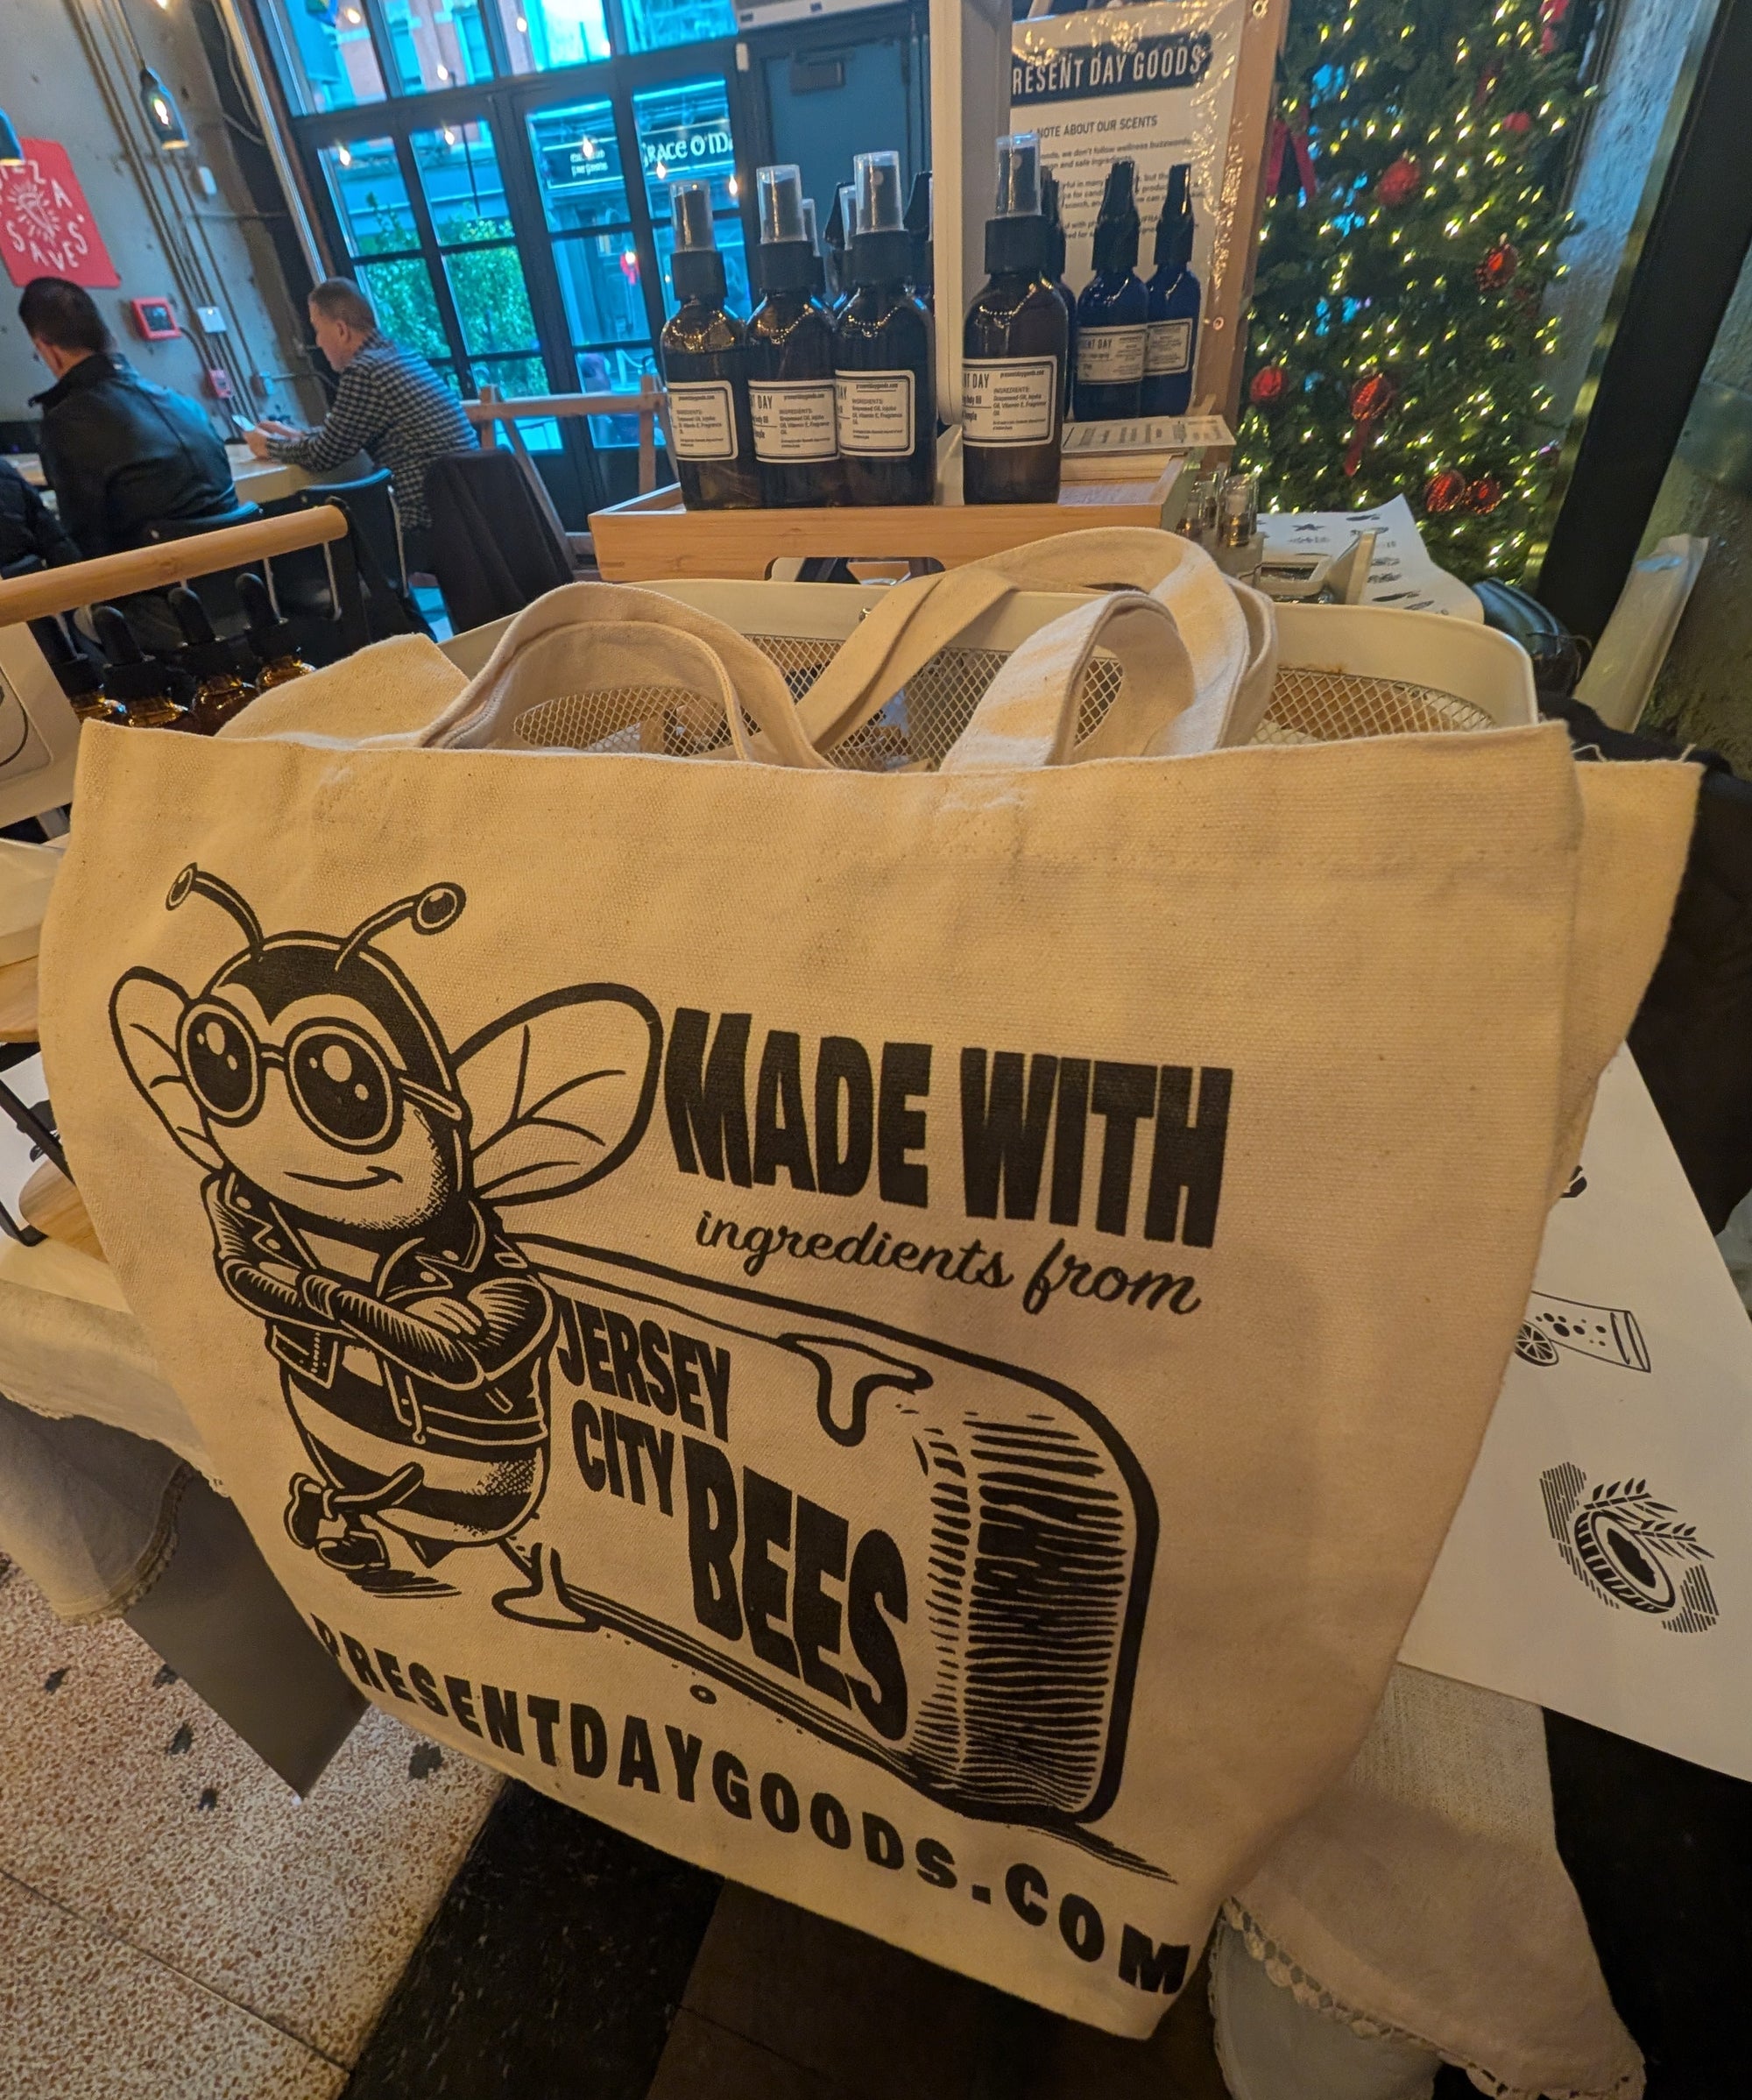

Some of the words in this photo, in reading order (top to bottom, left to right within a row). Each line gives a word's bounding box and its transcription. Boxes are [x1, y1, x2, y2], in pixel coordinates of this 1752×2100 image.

[1012, 58, 1084, 95] RESENT
[1090, 54, 1130, 86] DAY
[1133, 46, 1202, 81] GOODS
[1037, 126, 1061, 138] NOTE
[1063, 122, 1095, 135] ABOUT
[1097, 119, 1117, 131] OUR
[1120, 115, 1158, 130] SCENTS
[6, 221, 88, 272] SAVES
[757, 394, 773, 409] DAY
[973, 373, 989, 388] DAY
[665, 1008, 933, 1209] MADE
[960, 1046, 1233, 1248] WITH
[696, 1210, 1014, 1288] ingredients
[1021, 1239, 1201, 1314] from
[556, 1299, 731, 1443] JERSEY
[571, 1399, 675, 1517] CITY
[682, 1434, 908, 1741] BEES
[310, 1613, 1190, 1996] PRESENTDAYGOODS.COM
